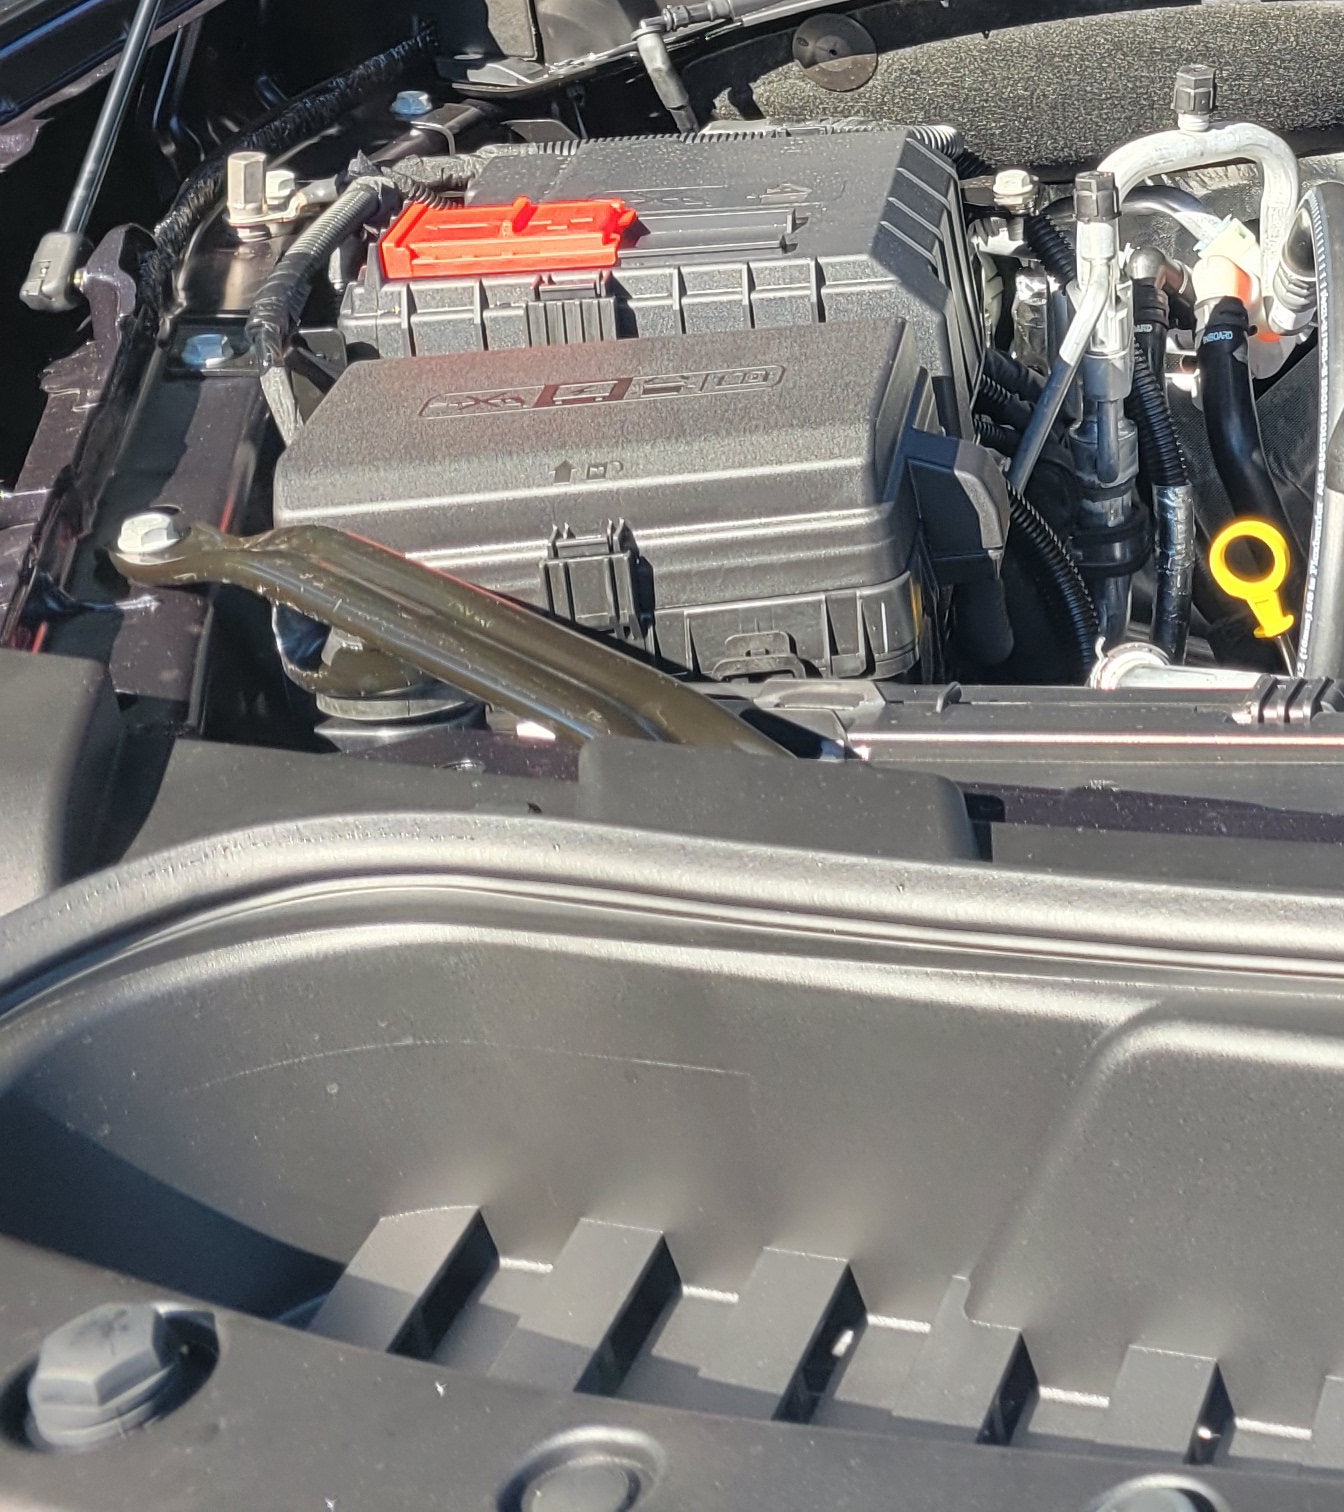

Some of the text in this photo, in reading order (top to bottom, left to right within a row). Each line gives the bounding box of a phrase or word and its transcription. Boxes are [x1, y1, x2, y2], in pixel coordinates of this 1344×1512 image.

[1319, 377, 1328, 413] HOSE
[1317, 414, 1327, 471] SUCTION
[1316, 472, 1325, 496] A/C
